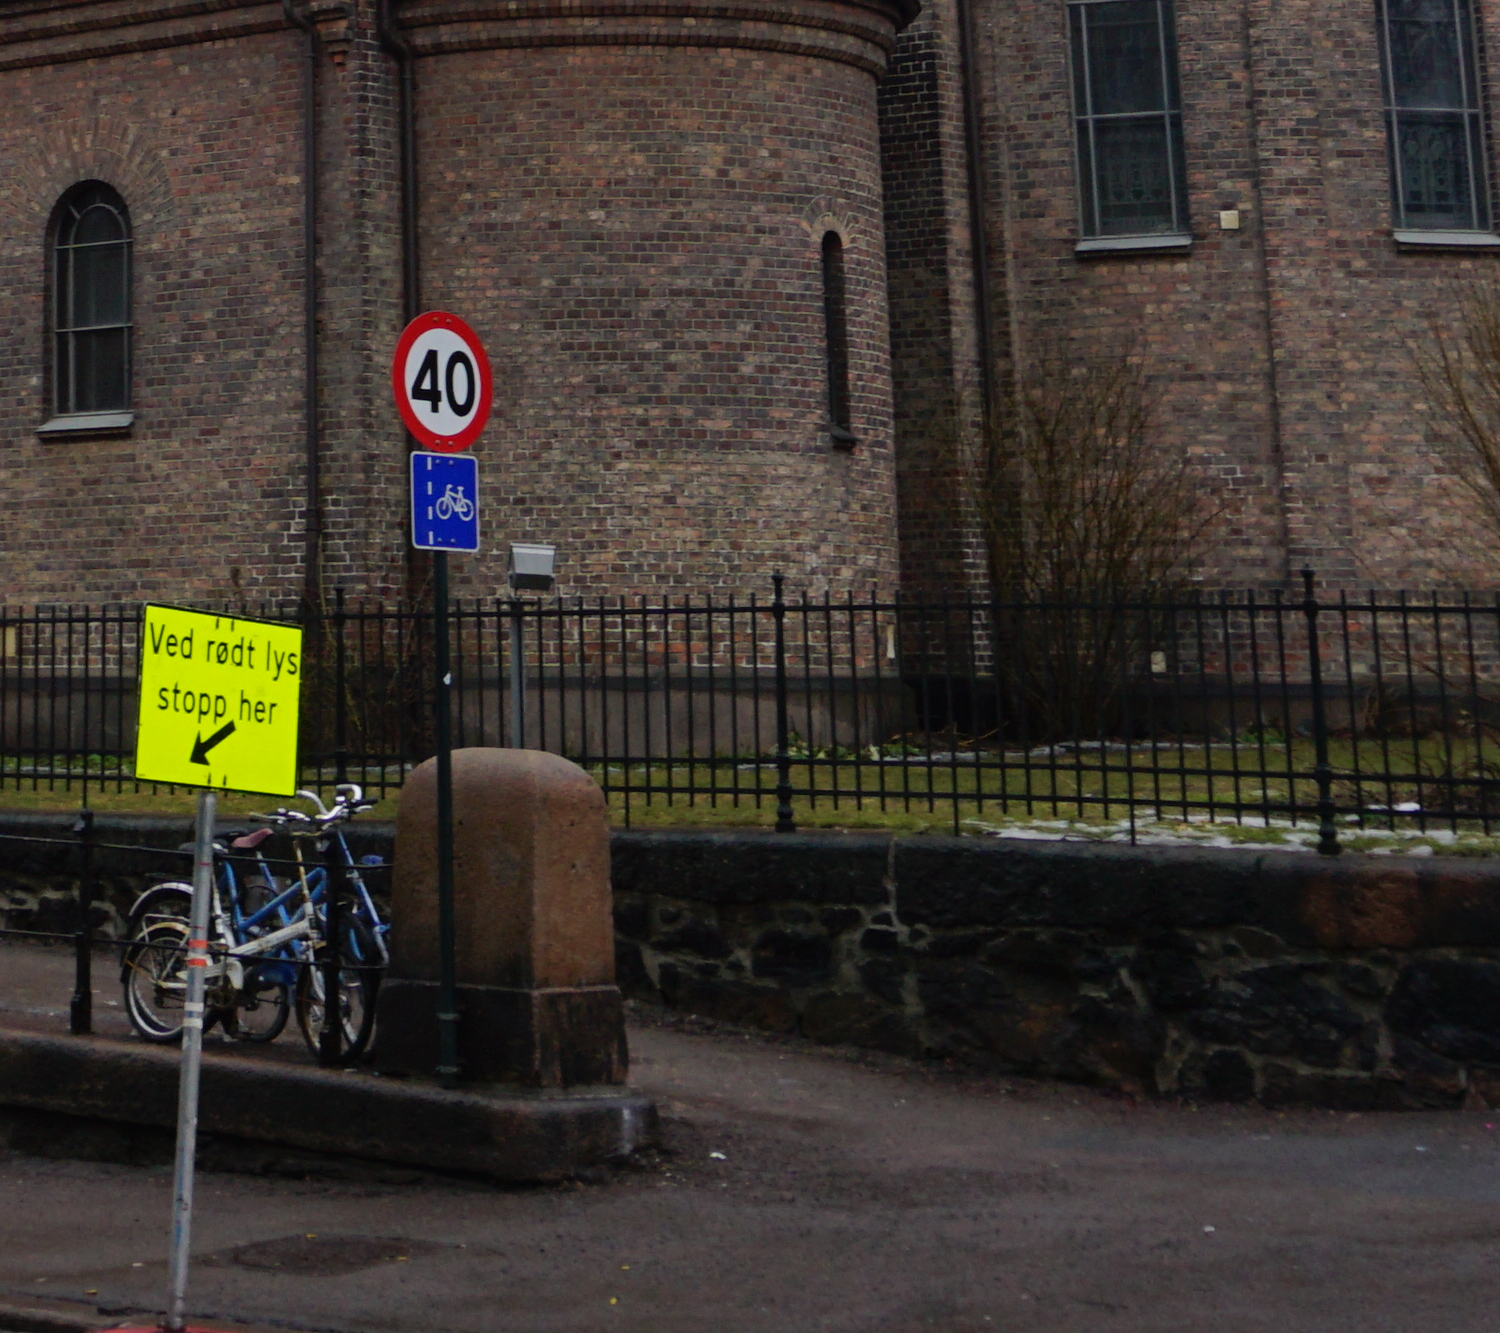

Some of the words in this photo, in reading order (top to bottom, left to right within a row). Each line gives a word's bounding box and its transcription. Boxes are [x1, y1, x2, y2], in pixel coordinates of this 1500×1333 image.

[411, 349, 475, 417] 40
[150, 622, 194, 659] Ved
[206, 636, 256, 670] rødt
[265, 640, 299, 682] lys
[157, 681, 227, 726] stopp
[239, 689, 278, 725] her
